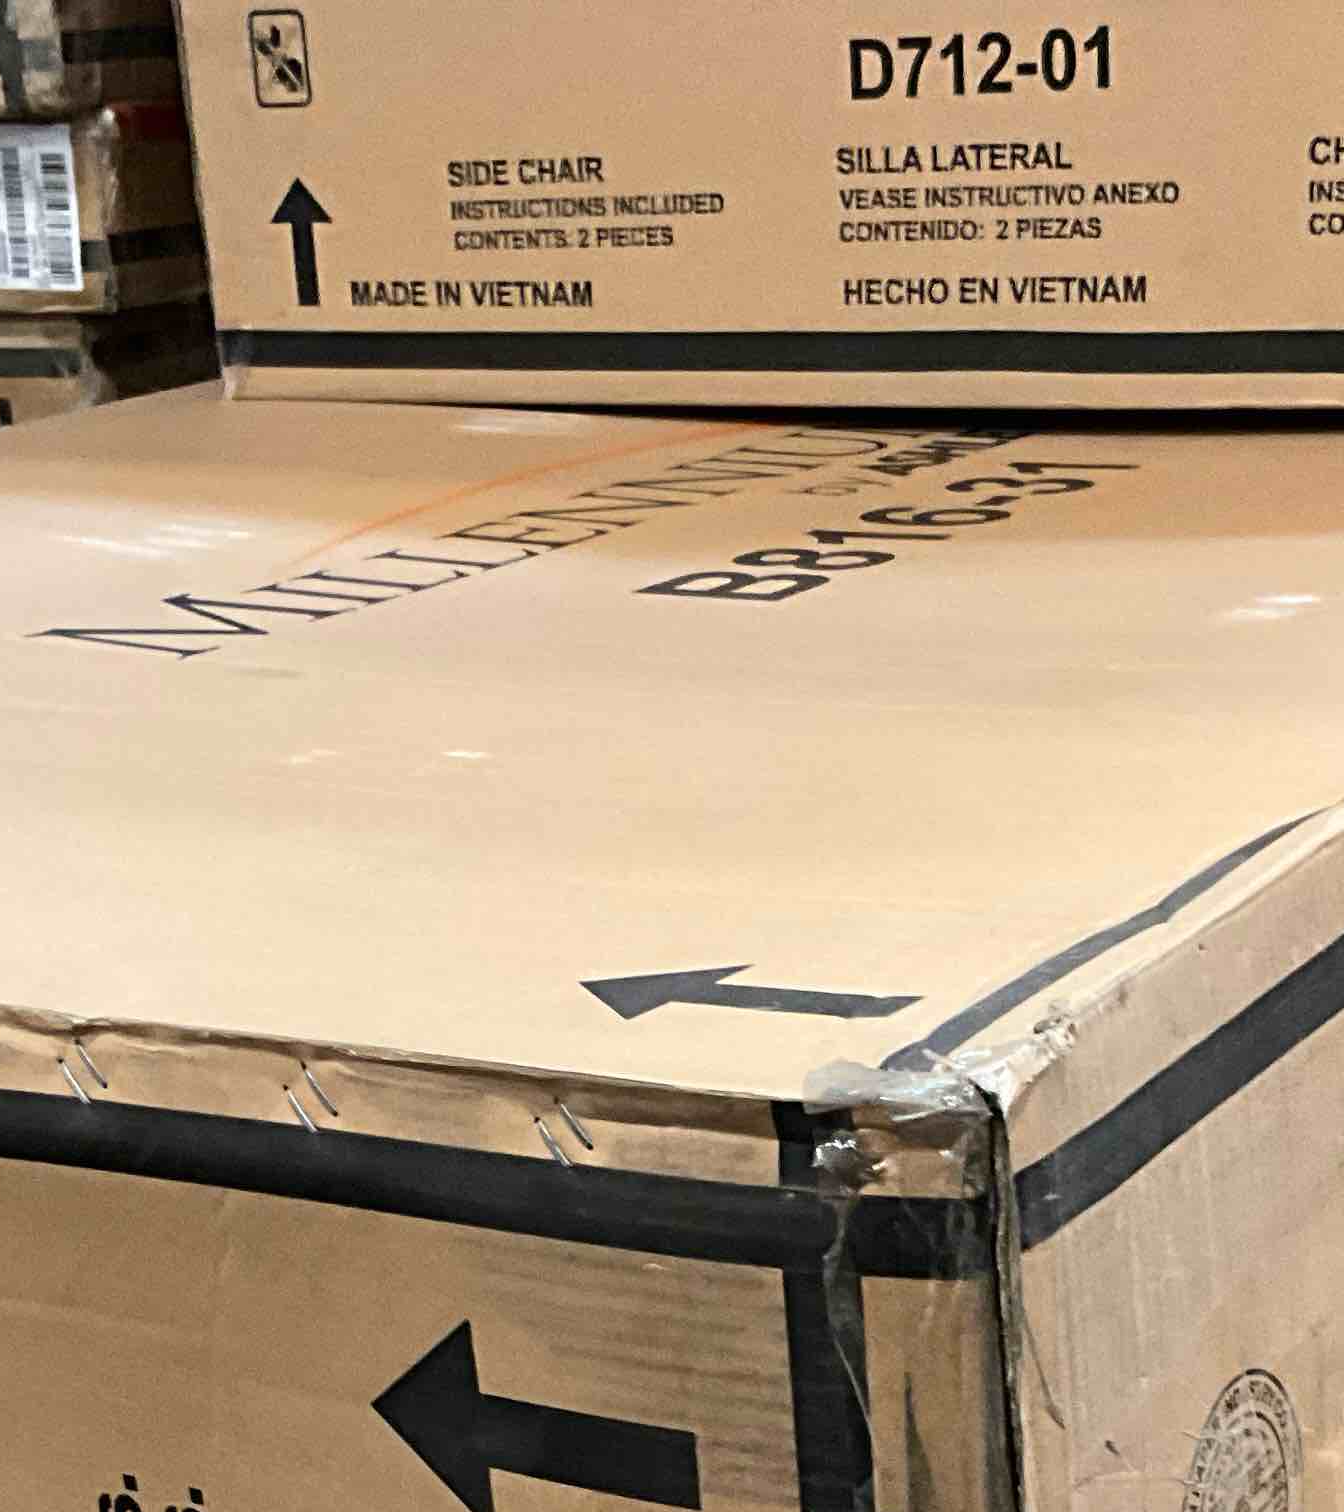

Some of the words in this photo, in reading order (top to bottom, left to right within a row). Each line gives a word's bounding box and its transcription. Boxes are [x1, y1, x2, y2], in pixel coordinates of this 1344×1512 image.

[848, 25, 1112, 101] D712-01
[447, 159, 510, 188] SIDE
[517, 157, 605, 184] CHAIR
[836, 145, 923, 175] SILLA
[931, 142, 1073, 173] LATERAL
[450, 196, 608, 220] INSTRUCTIONS
[612, 193, 725, 217] INCLUDED
[839, 186, 917, 210] VEASE
[924, 183, 1086, 209] INSTRUCTIVO
[1093, 181, 1181, 206] ANEXO
[577, 227, 590, 250] 2
[595, 225, 674, 248] PIECES
[838, 219, 985, 242] CONTENIDO:
[995, 219, 1010, 240] 2
[1015, 216, 1102, 240] PIEZAS
[350, 280, 428, 309] MADE
[435, 280, 462, 308] IN
[468, 279, 594, 308] VIETNAM
[843, 277, 949, 306] HECHO
[958, 276, 999, 305] EN
[1007, 274, 1148, 304] VIETNAM
[23, 431, 924, 659] MILLENNIU
[634, 461, 1141, 603] B816-31
